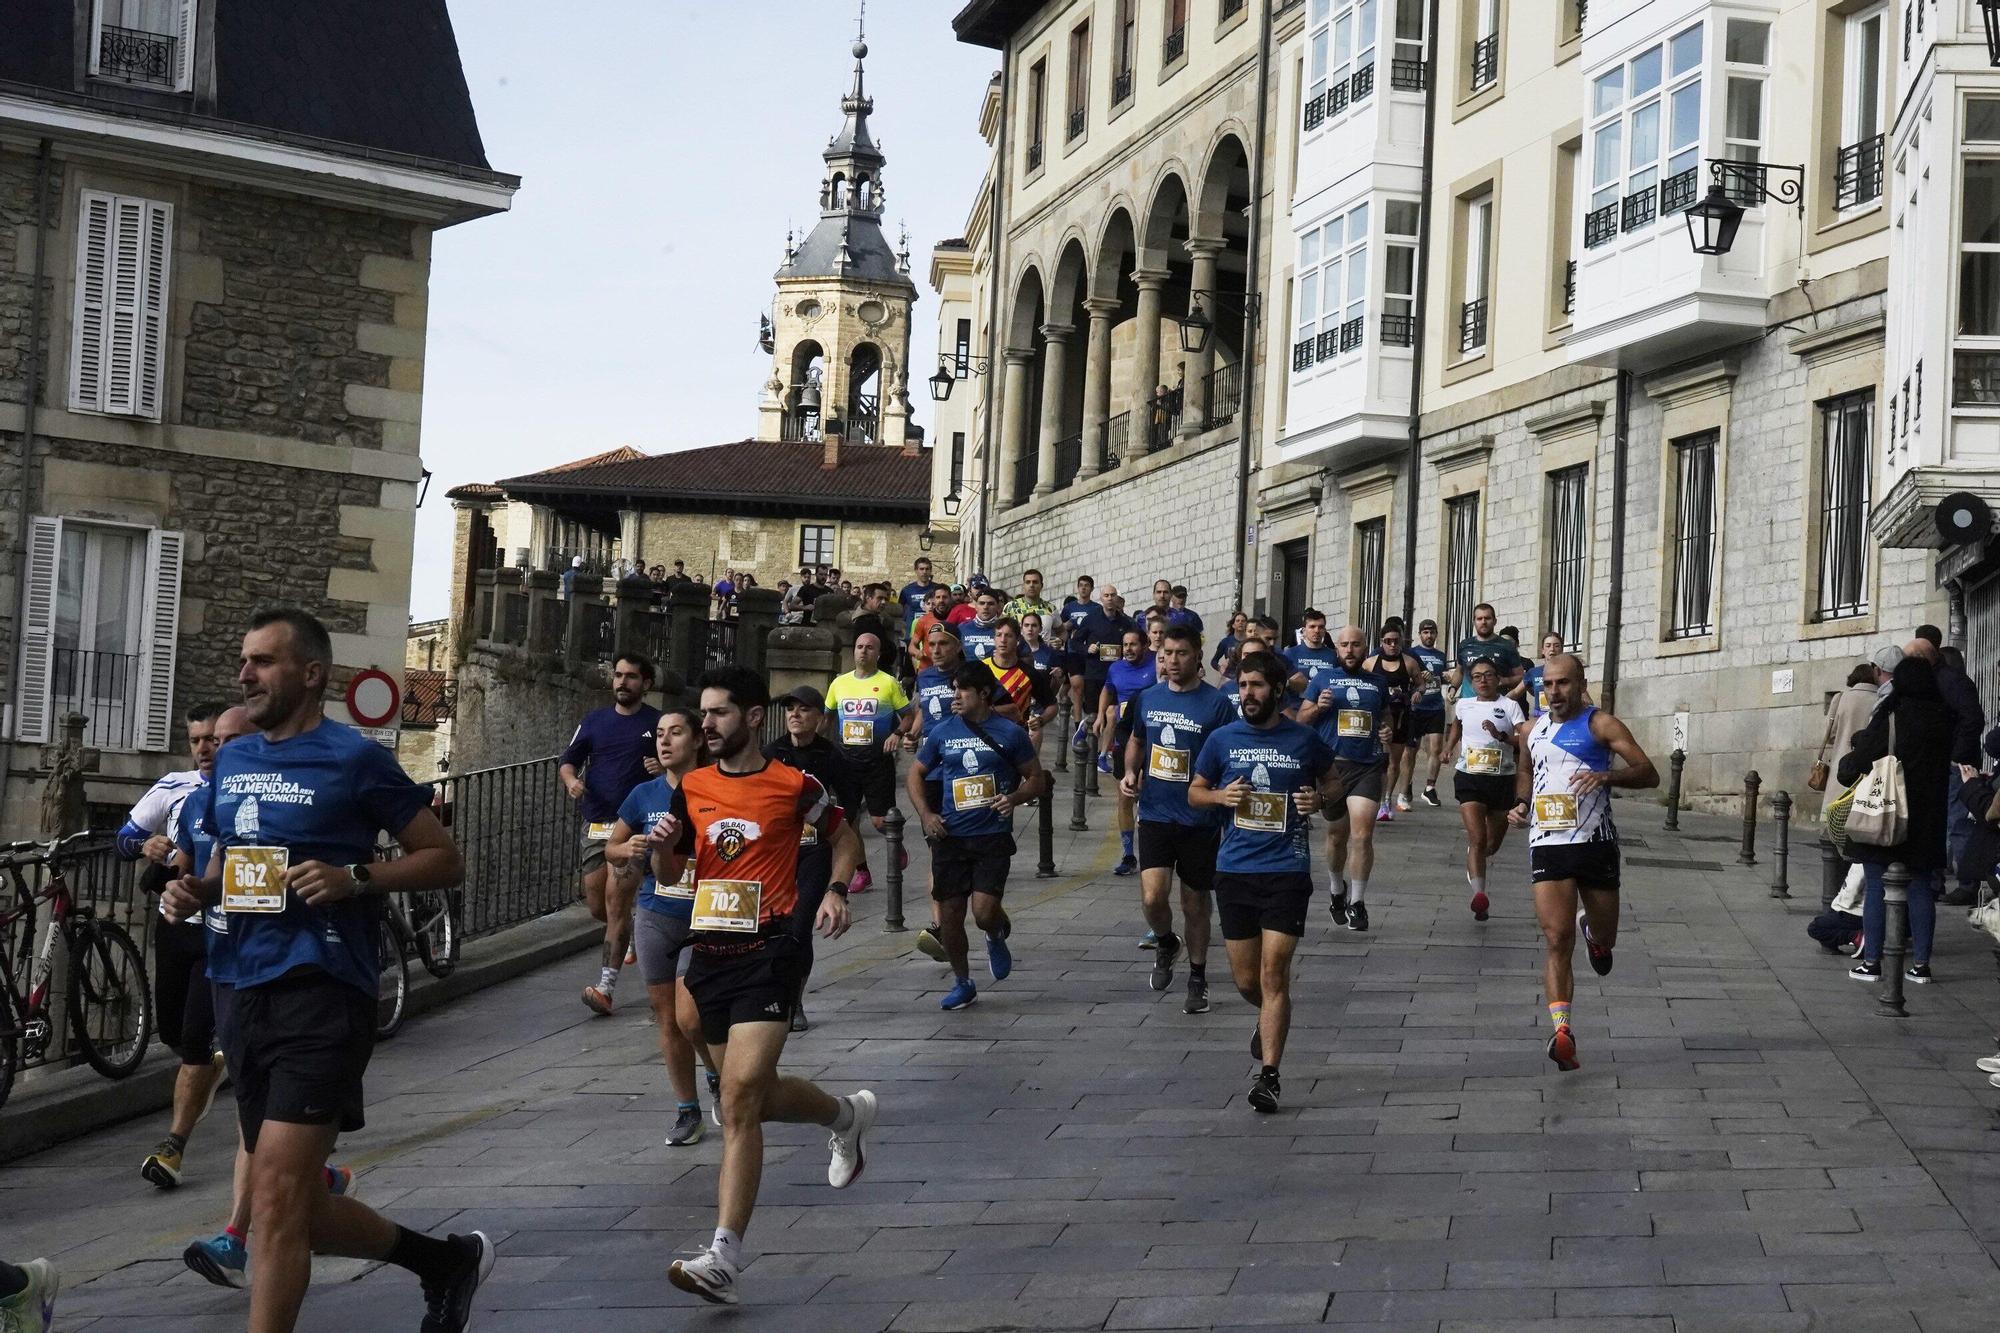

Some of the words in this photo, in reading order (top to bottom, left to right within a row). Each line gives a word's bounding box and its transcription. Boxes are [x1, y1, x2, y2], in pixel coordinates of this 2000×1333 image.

[1152, 715, 1194, 727] ALMENDRA
[1153, 711, 1185, 719] CONQUISTA
[1174, 724, 1202, 734] KONKISTA
[1159, 755, 1179, 770] 404
[1239, 754, 1292, 763] ALMENDRA
[222, 776, 231, 784] LA
[231, 773, 283, 783] CONQUISTA
[227, 782, 300, 794] ALMENDRA
[299, 788, 315, 796] REN
[964, 783, 984, 797] 627
[259, 793, 313, 806] KONKISTA
[1249, 801, 1272, 817] 192
[1544, 802, 1564, 816] 135
[720, 821, 746, 832] BILBAO
[722, 829, 740, 838] BEER
[234, 863, 267, 887] 562
[710, 892, 740, 912] 702
